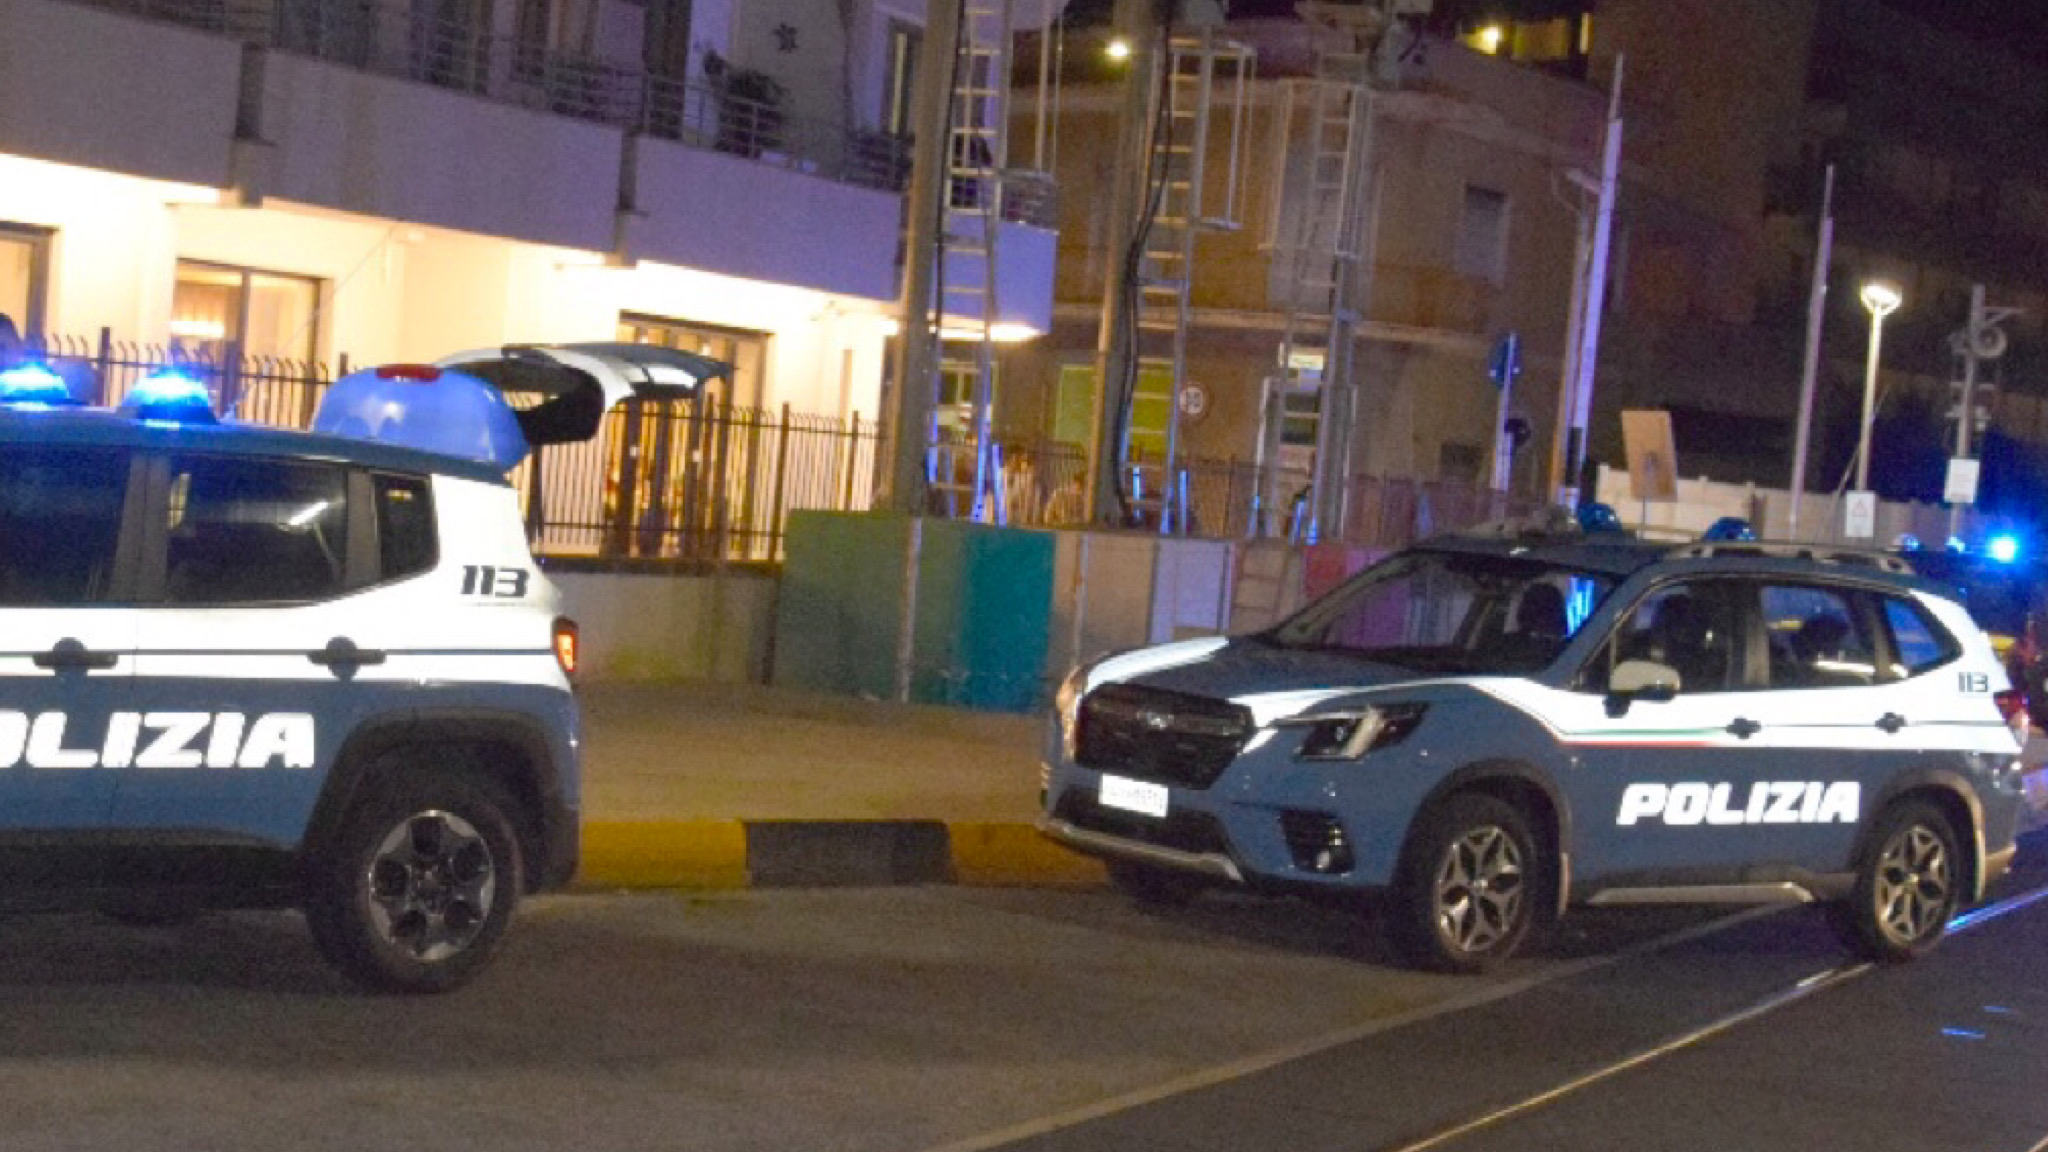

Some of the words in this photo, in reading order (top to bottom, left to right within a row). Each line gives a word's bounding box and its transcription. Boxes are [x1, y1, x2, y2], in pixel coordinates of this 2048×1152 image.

[461, 565, 529, 598] 113
[1958, 672, 1988, 692] 113
[1616, 782, 1860, 825] POLIZIA
